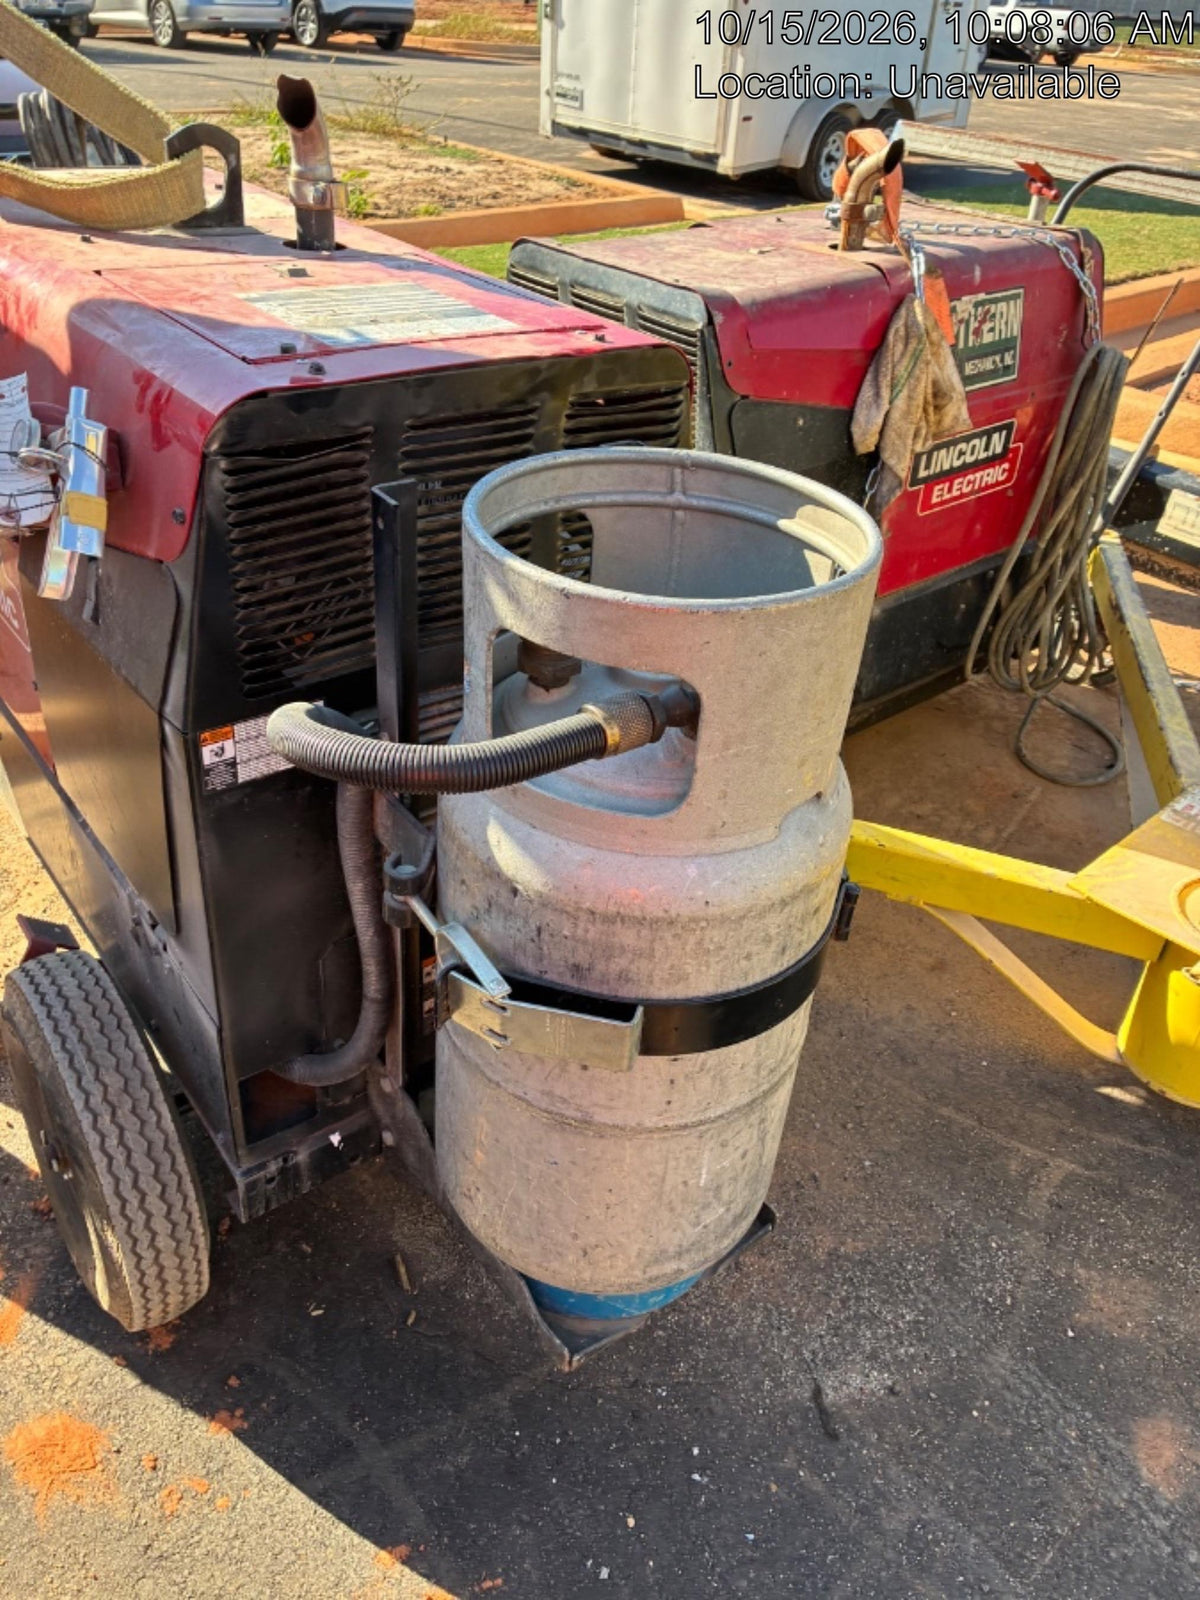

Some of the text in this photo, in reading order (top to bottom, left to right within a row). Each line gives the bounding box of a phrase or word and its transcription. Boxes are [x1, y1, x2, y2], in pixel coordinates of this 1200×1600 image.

[951, 299, 1020, 349] THERN
[917, 429, 1007, 479] LINCOLN
[931, 463, 1010, 504] ELECTRIC
